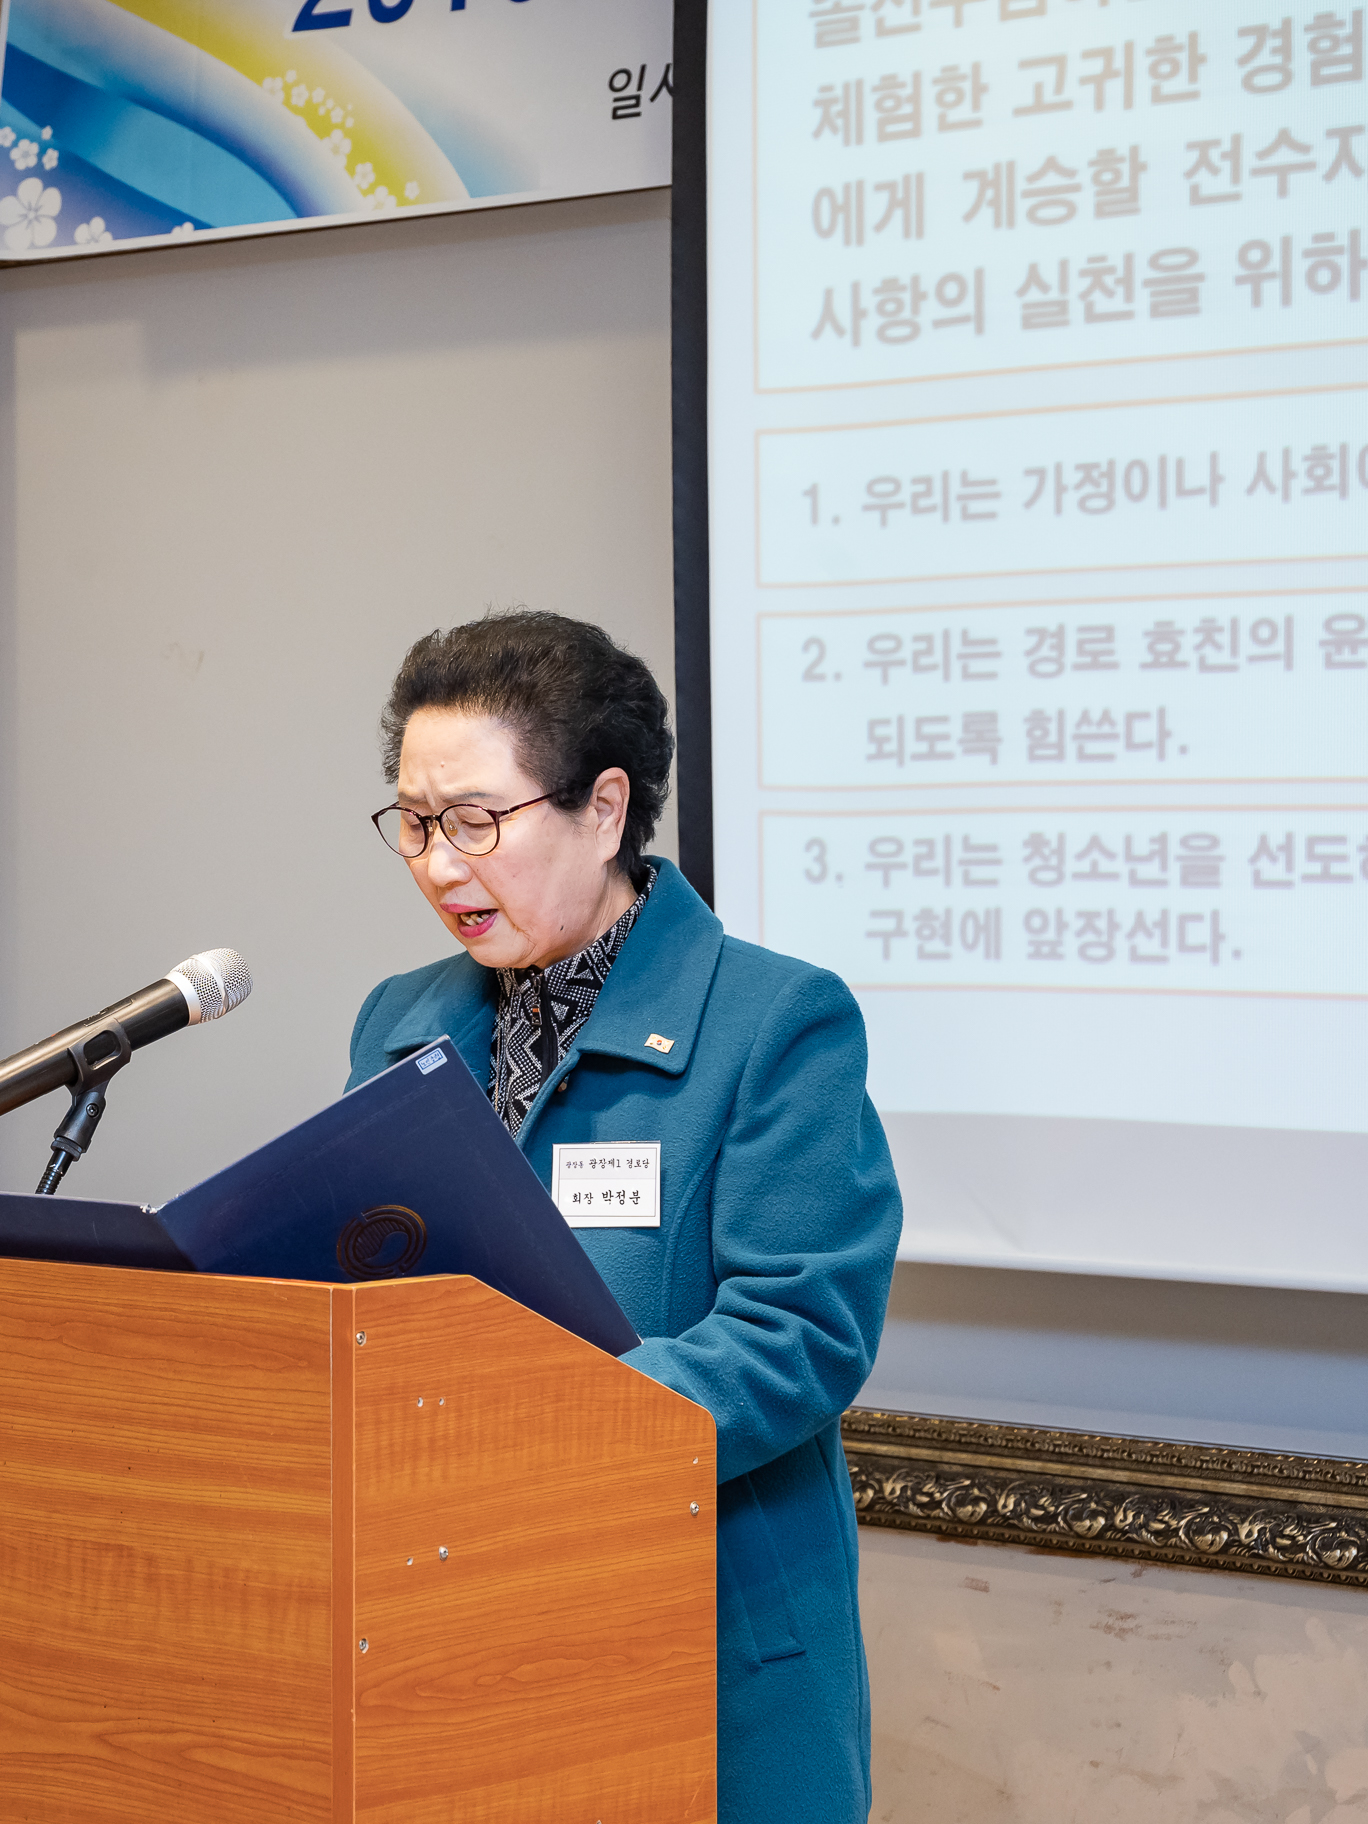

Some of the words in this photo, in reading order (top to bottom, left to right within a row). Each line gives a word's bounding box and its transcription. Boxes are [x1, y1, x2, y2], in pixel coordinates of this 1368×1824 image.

[812, 61, 989, 147] 체험한
[1012, 30, 1208, 118] 고귀한
[811, 171, 925, 247] 에게
[962, 144, 1148, 230] 계승할
[810, 267, 986, 348] 사항의
[1014, 247, 1207, 331] 실천을
[802, 483, 840, 526] 1.
[861, 469, 1002, 528] 우리는
[1023, 451, 1226, 517] 가정이나
[1244, 442, 1368, 504] 사회
[802, 637, 842, 682] 2.
[863, 628, 1003, 686] 우리는
[1024, 623, 1121, 679] 경로
[1138, 614, 1294, 674] 효친의
[866, 711, 1004, 768] 되도록
[1023, 706, 1189, 763] 힘쓴다.
[804, 837, 843, 884] 3.
[864, 833, 1003, 889] 우리는
[1022, 832, 1226, 889] 청소년을
[1247, 831, 1368, 890] 선도
[865, 907, 1003, 962] 구현에
[1023, 907, 1243, 966] 앞장선다.
[626, 1158, 649, 1169] 경로당
[572, 1192, 593, 1205] 회장
